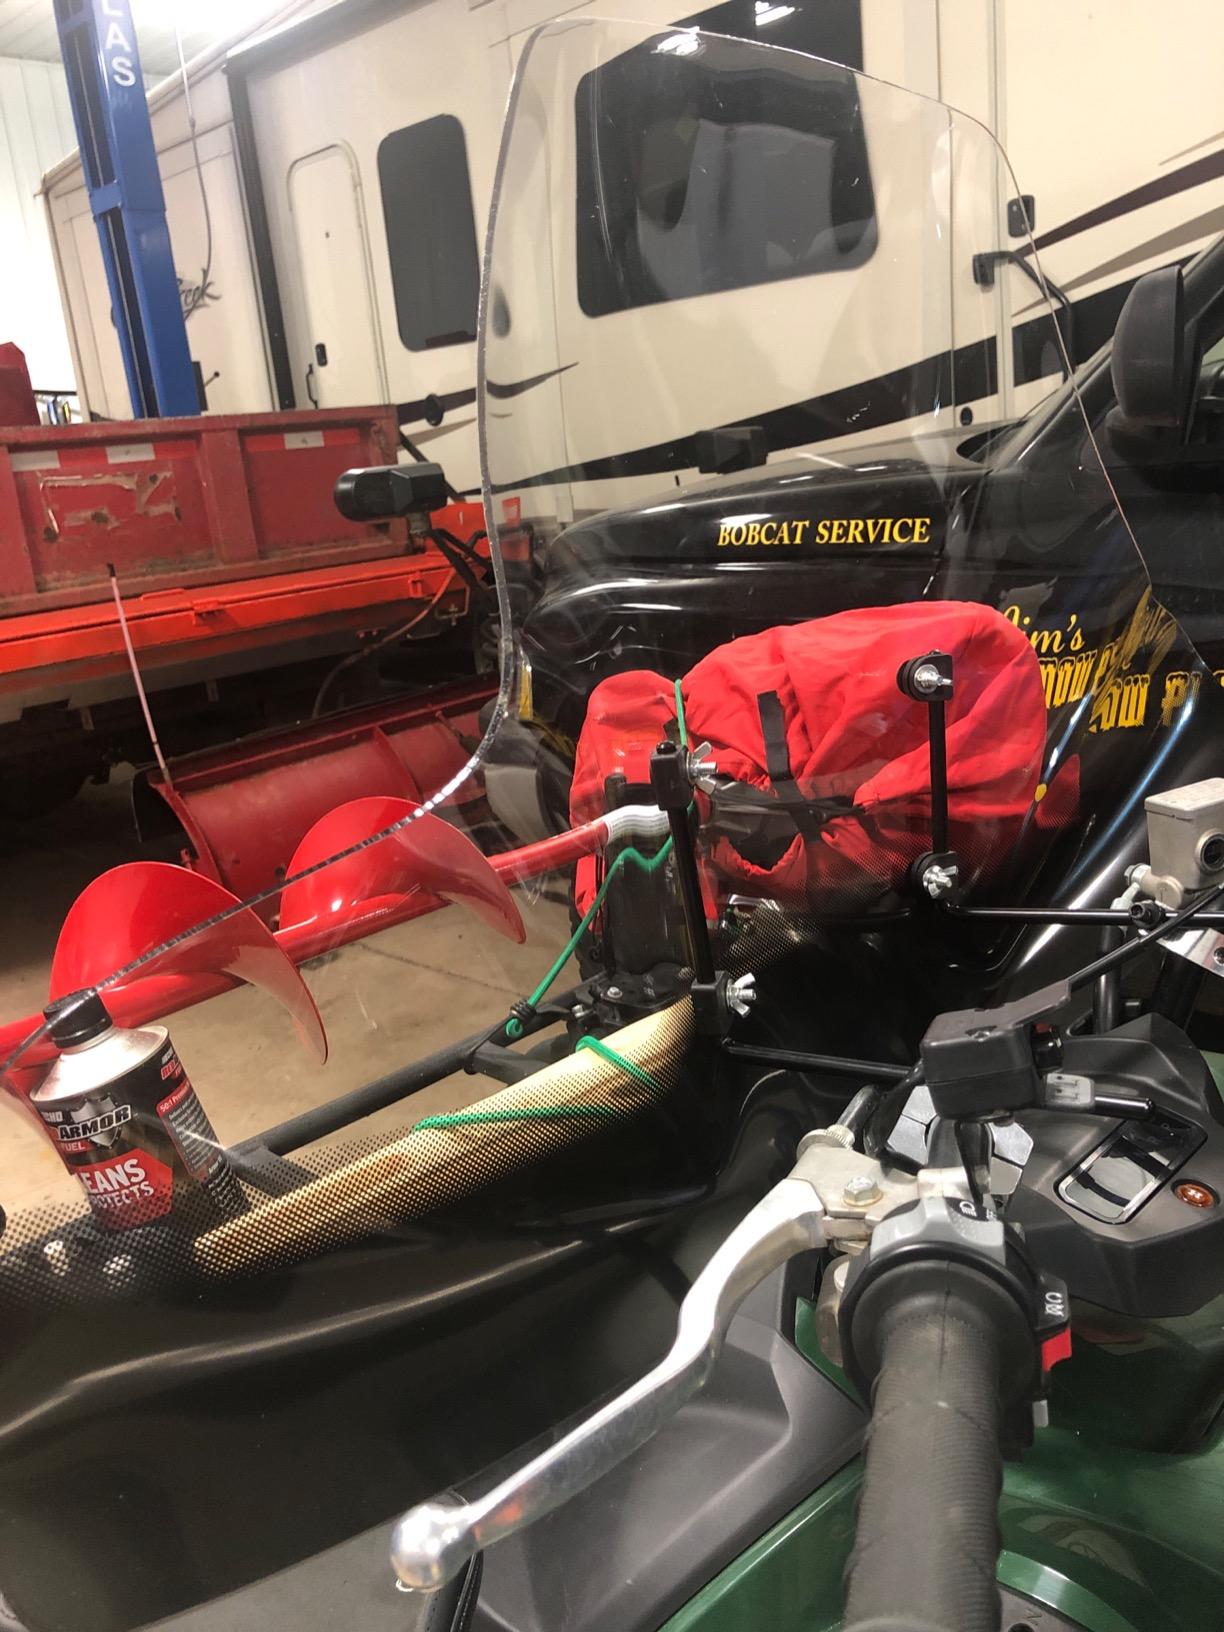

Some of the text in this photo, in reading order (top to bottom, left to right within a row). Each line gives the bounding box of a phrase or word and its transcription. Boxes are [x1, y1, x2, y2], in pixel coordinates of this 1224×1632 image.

[717, 518, 931, 546] BOBCAT SERVICE
[1037, 650, 1098, 709] now
[58, 1104, 132, 1142] ARMOR
[78, 1158, 146, 1194] EANS
